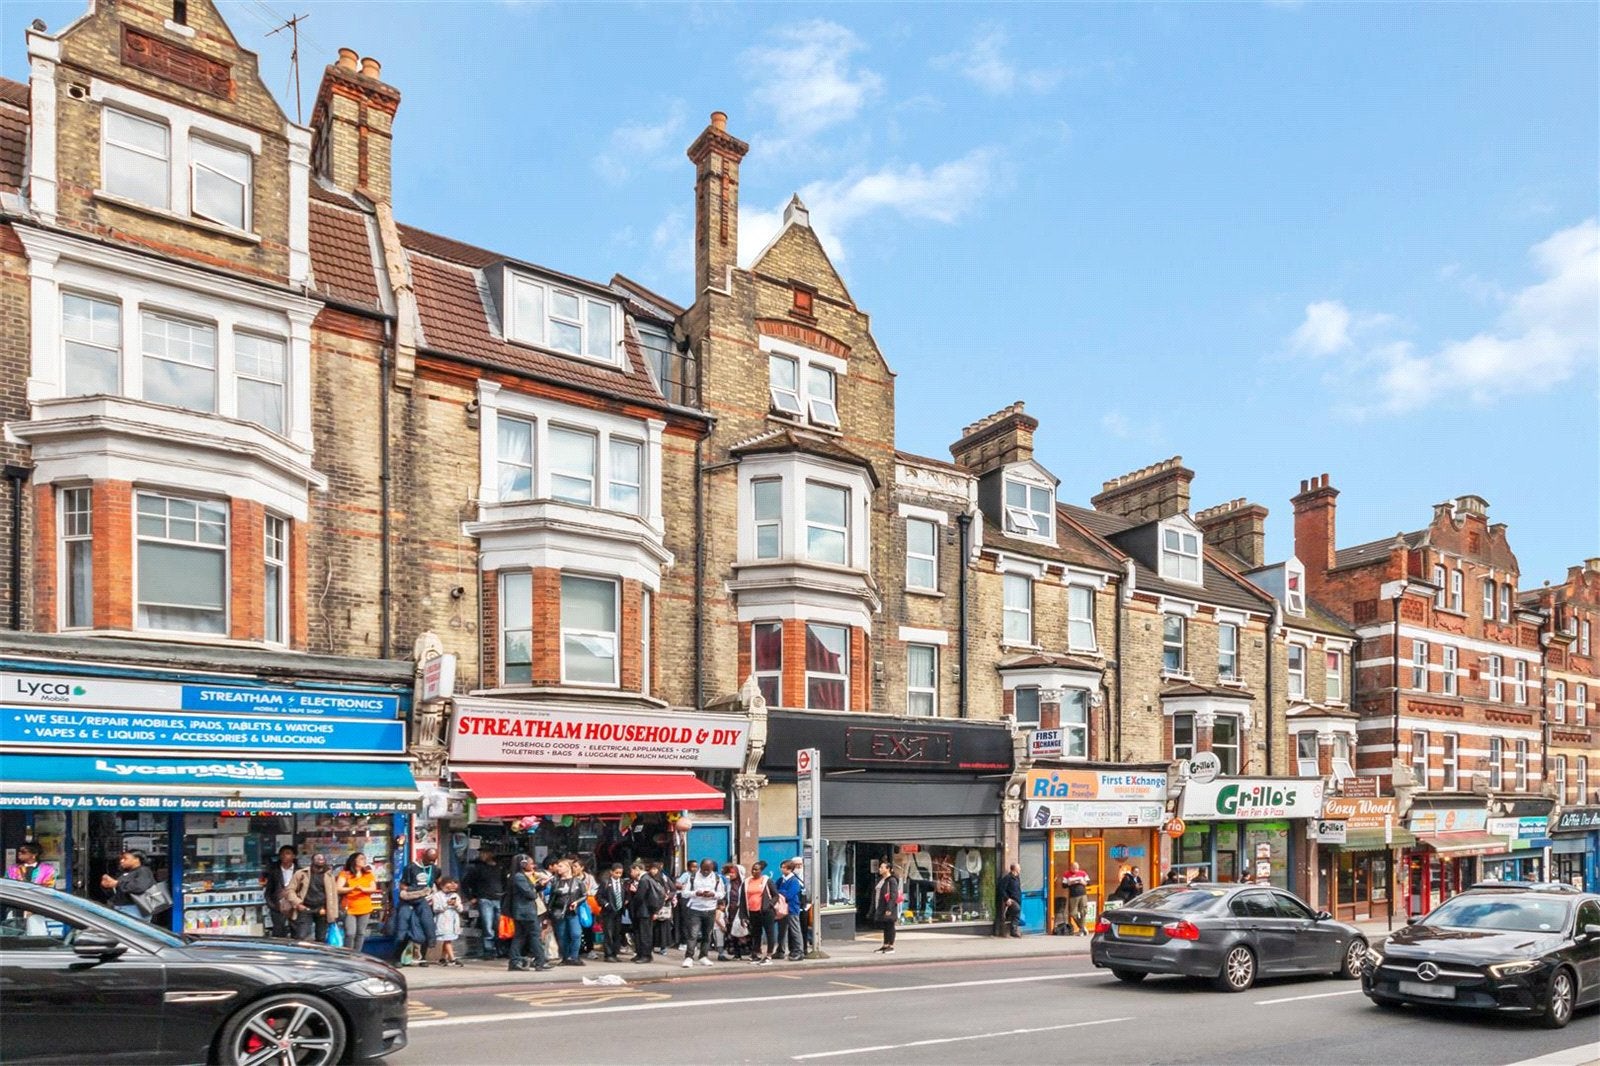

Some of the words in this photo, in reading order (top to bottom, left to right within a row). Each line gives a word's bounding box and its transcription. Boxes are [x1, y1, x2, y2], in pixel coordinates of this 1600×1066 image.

[17, 678, 69, 696] Lyca
[200, 690, 283, 705] STREATHAM
[300, 697, 384, 710] ELECTRONICS
[24, 714, 46, 724] WE
[50, 714, 129, 728] SELL/REPAIR
[227, 721, 272, 731] TABLETS
[274, 723, 283, 732] &
[285, 723, 334, 733] WATCHES
[458, 716, 583, 740] STREATHAM
[585, 723, 692, 744] HOUSEHOLD
[695, 729, 709, 745] &
[711, 730, 741, 746] DIY
[35, 727, 75, 738] VAPES
[78, 729, 88, 739] &
[107, 731, 156, 741] LIQUIDS
[172, 732, 248, 743] ACCESSORIES
[250, 735, 259, 743] &
[261, 735, 326, 744] UNLOCKING
[1036, 732, 1058, 740] FIRST
[589, 744, 631, 752] ELECTRICAL
[1033, 740, 1061, 749] EXCHANGE
[95, 760, 284, 778] Lycamobile
[1033, 773, 1069, 797] Ria
[1102, 775, 1123, 785] First
[53, 797, 75, 808] Pay
[78, 797, 93, 807] As
[96, 798, 117, 807] You
[120, 798, 136, 807] Go
[138, 798, 160, 807] SIM
[162, 798, 178, 808] for
[181, 799, 200, 808] low
[202, 800, 225, 808] cost
[227, 799, 291, 809] International
[292, 800, 312, 810] and
[313, 801, 328, 810] UK
[355, 802, 377, 811] texts
[379, 802, 395, 811] and
[397, 802, 416, 811] data
[1216, 785, 1296, 815] Grillo's
[1326, 800, 1357, 816] Cozy
[1357, 800, 1395, 814] Woods
